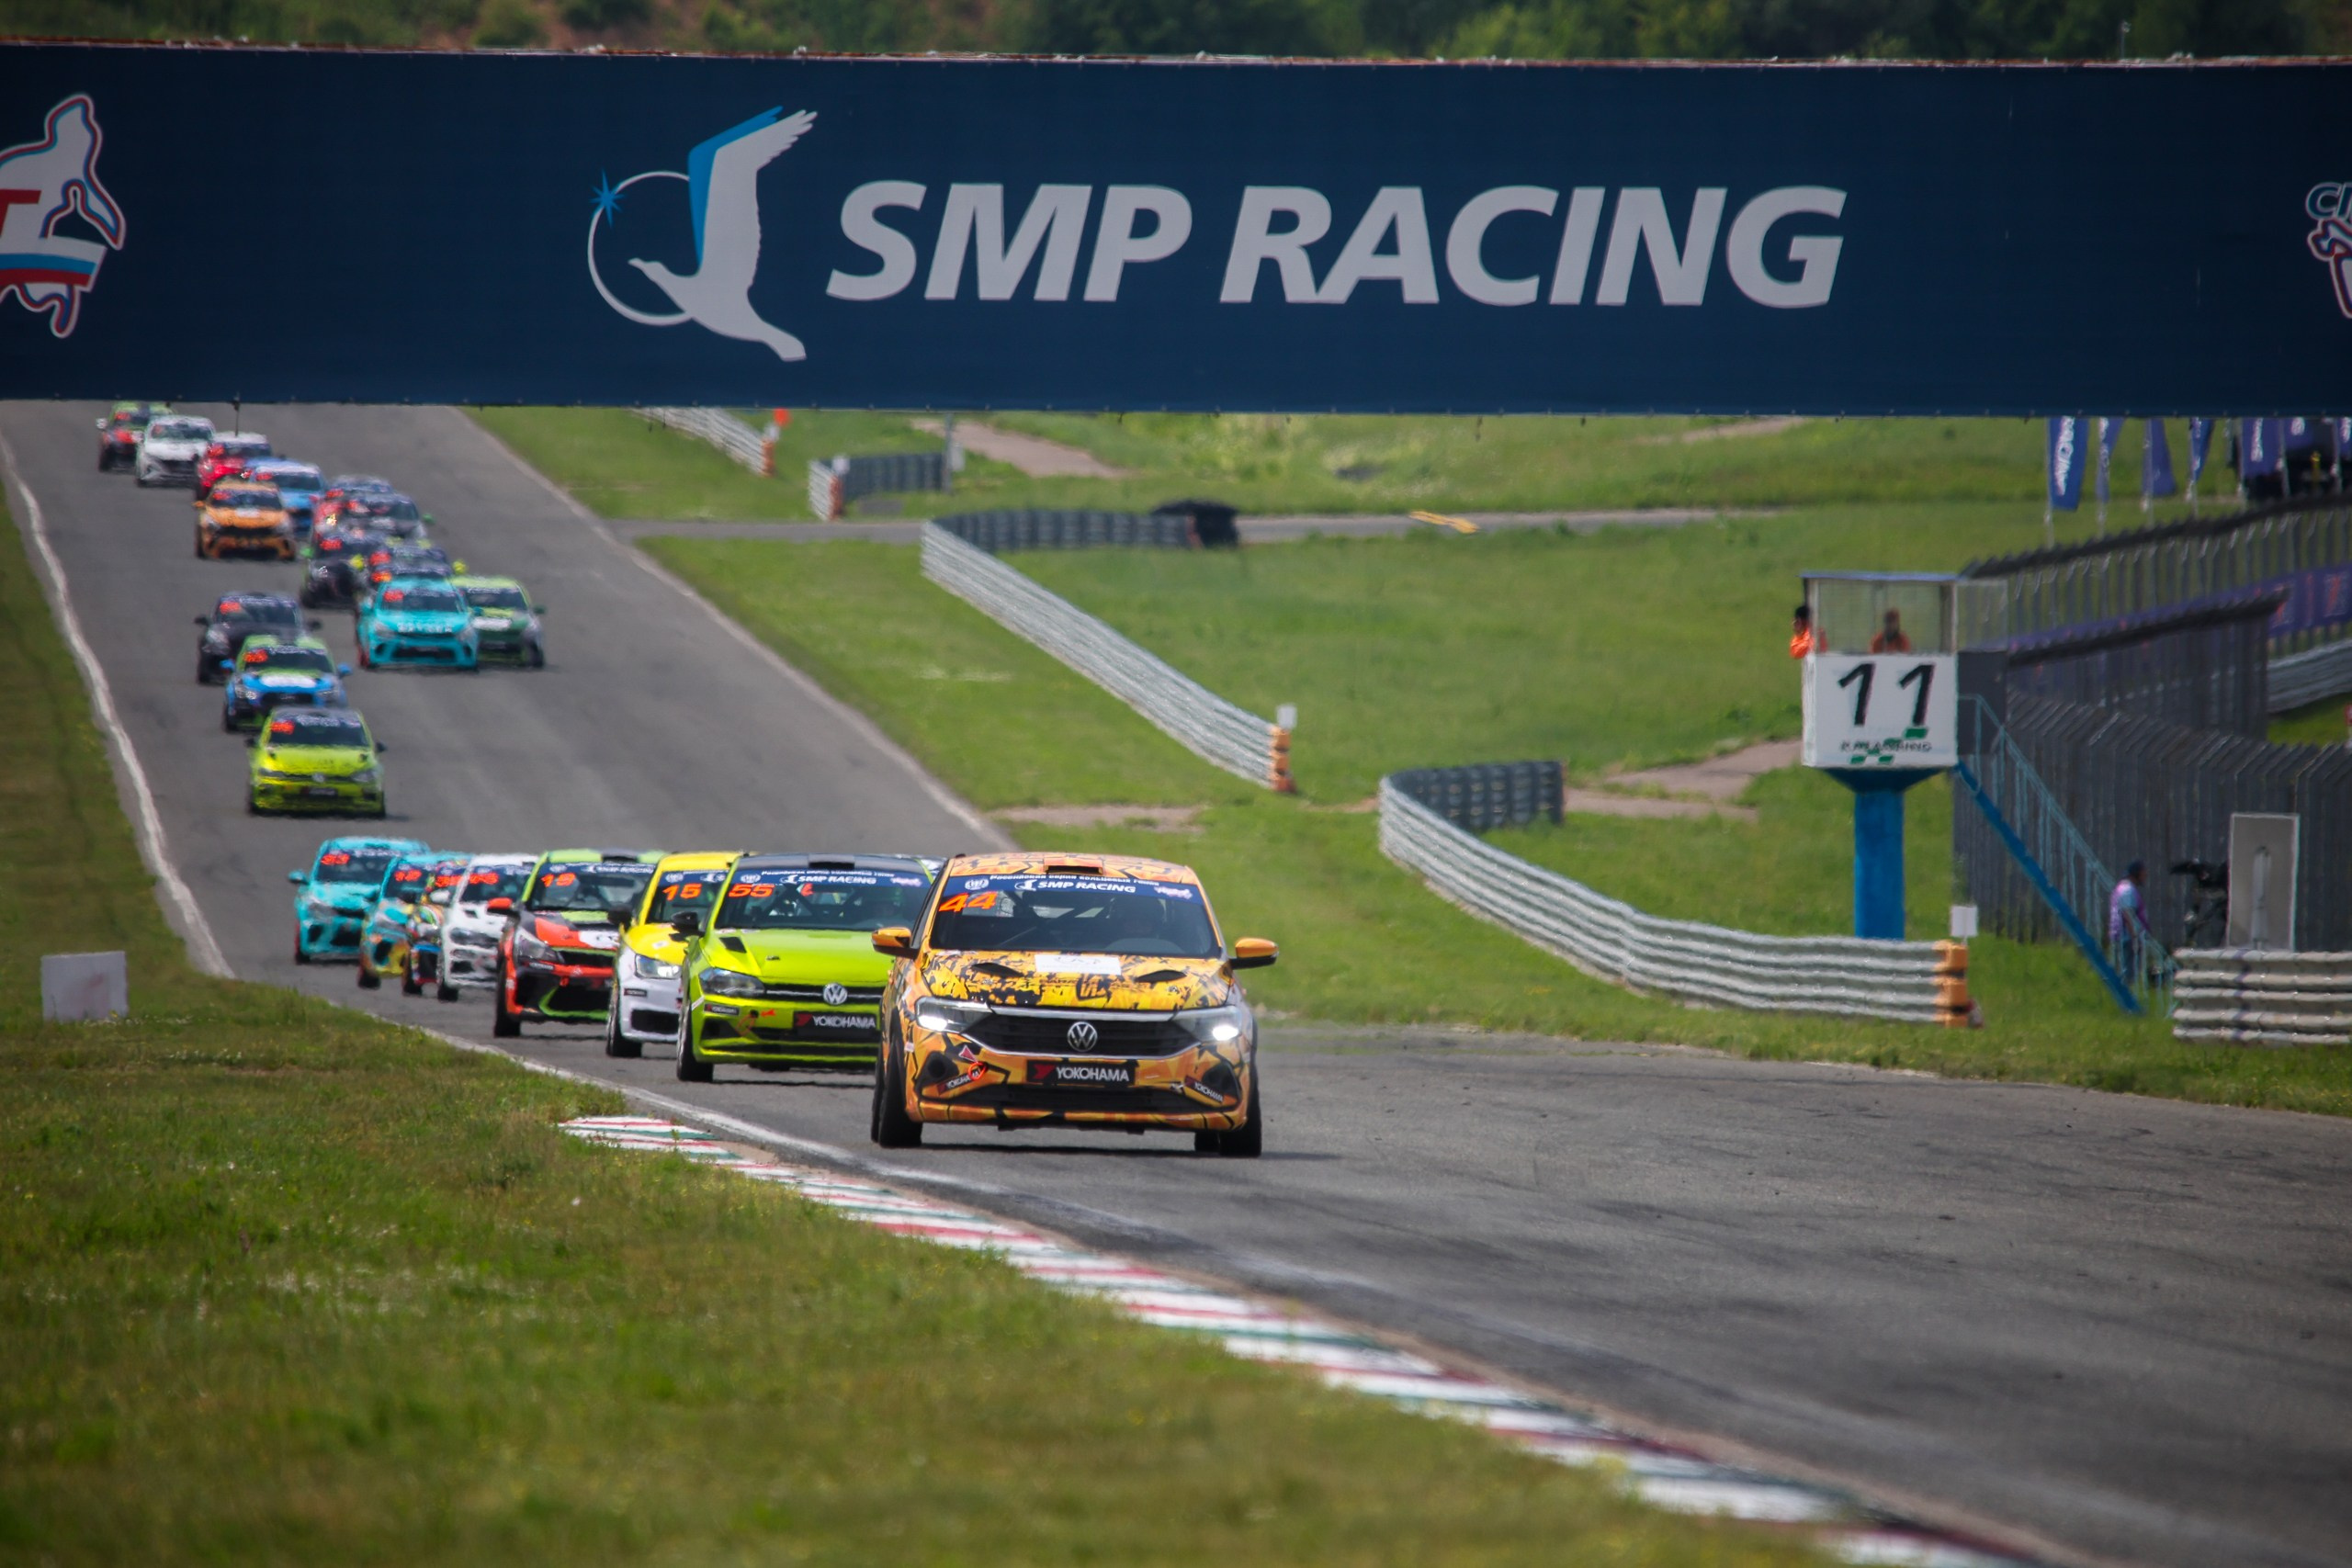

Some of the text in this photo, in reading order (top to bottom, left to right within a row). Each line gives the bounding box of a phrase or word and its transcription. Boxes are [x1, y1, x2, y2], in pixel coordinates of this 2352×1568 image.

[826, 180, 1848, 309] SMP RACING
[1838, 662, 1936, 726] 11
[662, 883, 703, 901] 15
[729, 883, 775, 897] 55
[1075, 882, 1136, 893] RACING
[938, 891, 998, 913] 44
[813, 1014, 876, 1029] YOKOHAMA
[1057, 1066, 1129, 1082] YOKOHAMA
